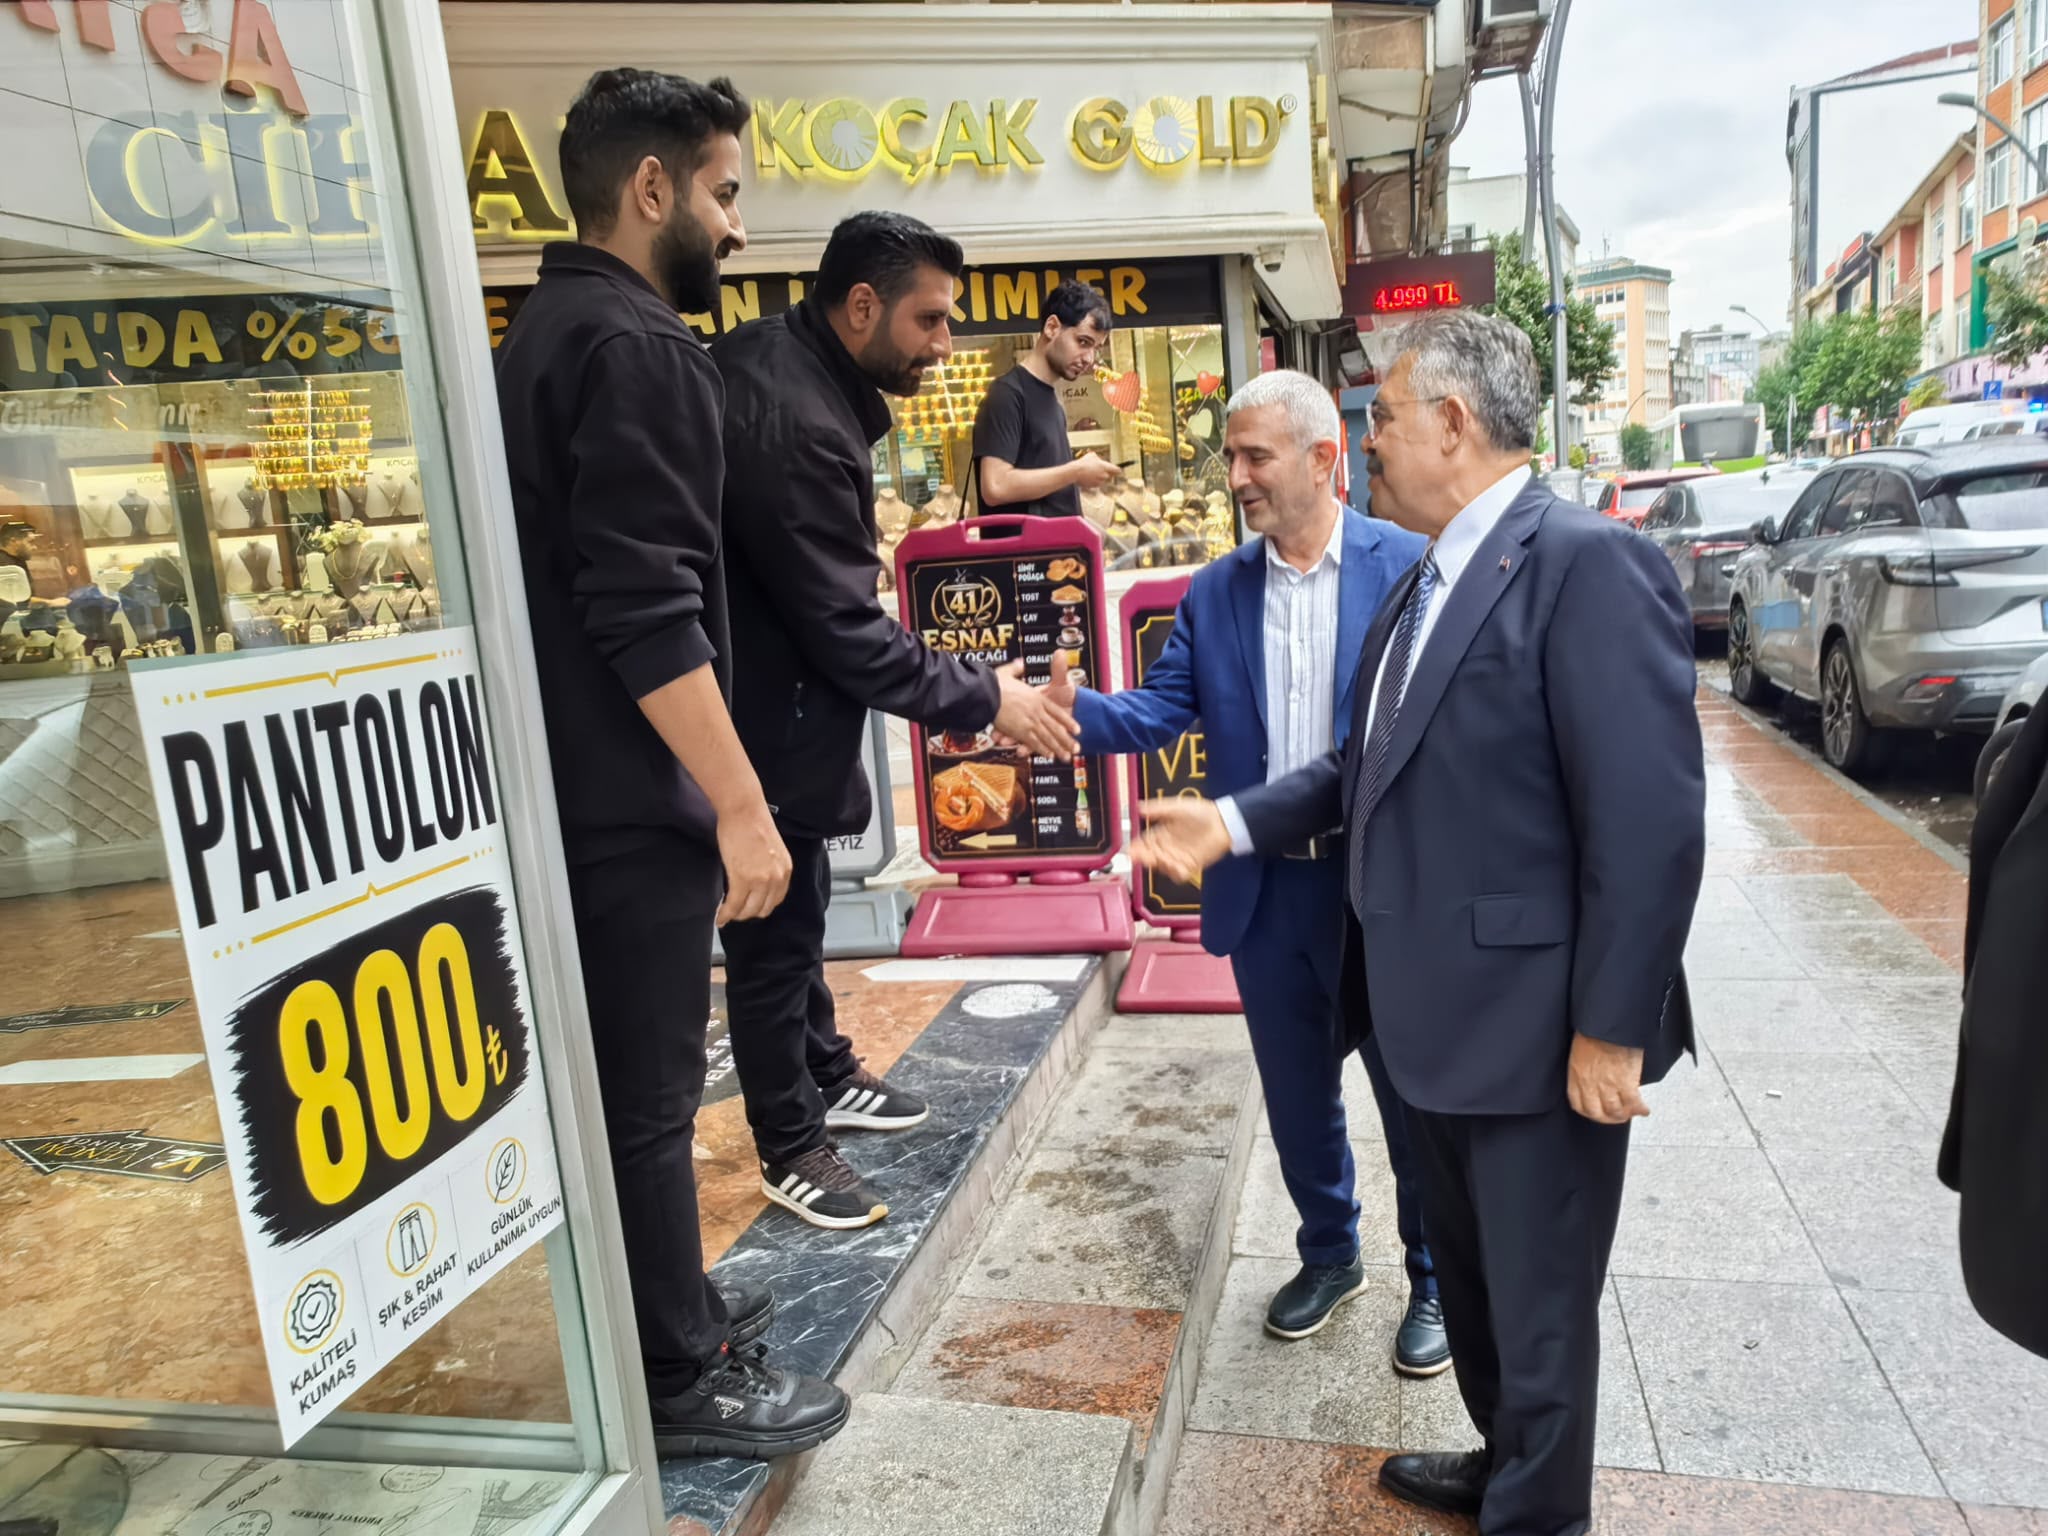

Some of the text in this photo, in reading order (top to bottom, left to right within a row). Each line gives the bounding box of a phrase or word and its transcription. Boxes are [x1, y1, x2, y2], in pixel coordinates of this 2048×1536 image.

[756, 97, 1044, 176] KOÇAK
[1433, 281, 1460, 304] TL
[949, 589, 978, 615] 41
[1021, 592, 1040, 602] TOST
[1023, 613, 1039, 624] ÇAY
[922, 624, 1014, 652] ESNAF
[1024, 633, 1049, 643] KAHVE
[161, 674, 498, 930] PANTOLON
[466, 1195, 562, 1277] KULLANIMA UYGUN
[490, 1194, 534, 1236] GÜNLÜK
[377, 1297, 402, 1328] ŞIK
[416, 1252, 458, 1296] RAHAT
[402, 1287, 444, 1332] KESİM
[290, 1327, 358, 1397] KALİTELİ
[299, 1358, 358, 1416] KUMAŞ
